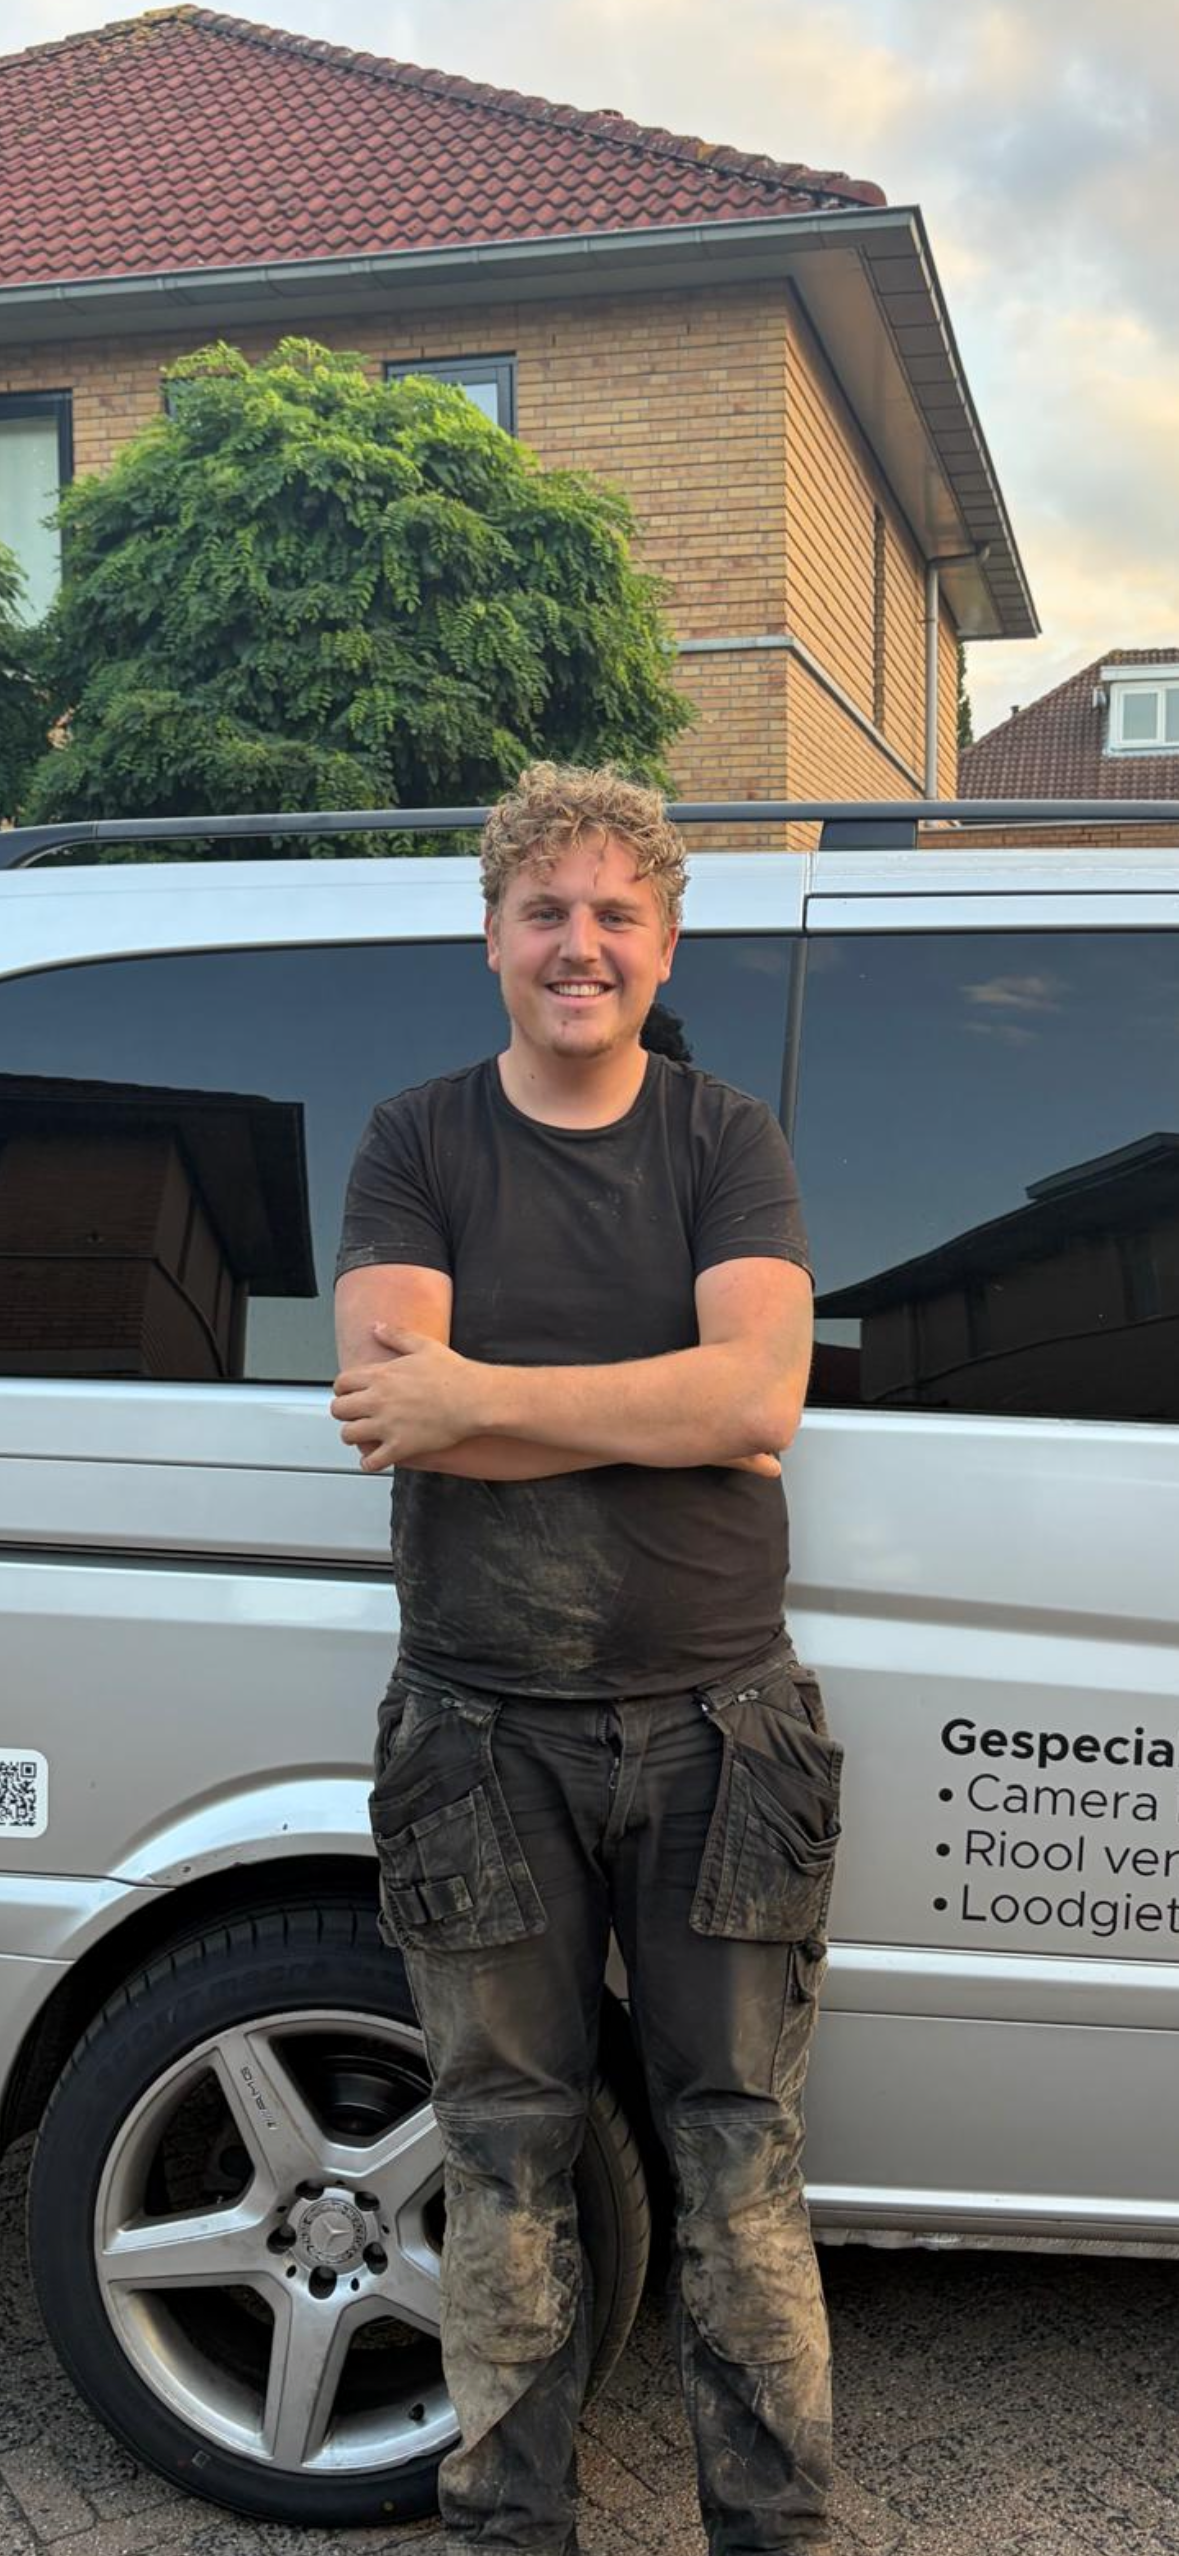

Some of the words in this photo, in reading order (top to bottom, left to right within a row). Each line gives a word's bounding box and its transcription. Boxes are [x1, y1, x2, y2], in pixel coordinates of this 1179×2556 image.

[941, 1718, 1175, 1769] Gespecia
[967, 1773, 1157, 1822] Camera
[965, 1829, 1085, 1873] Riool
[961, 1883, 1179, 1938] Loodgiet
